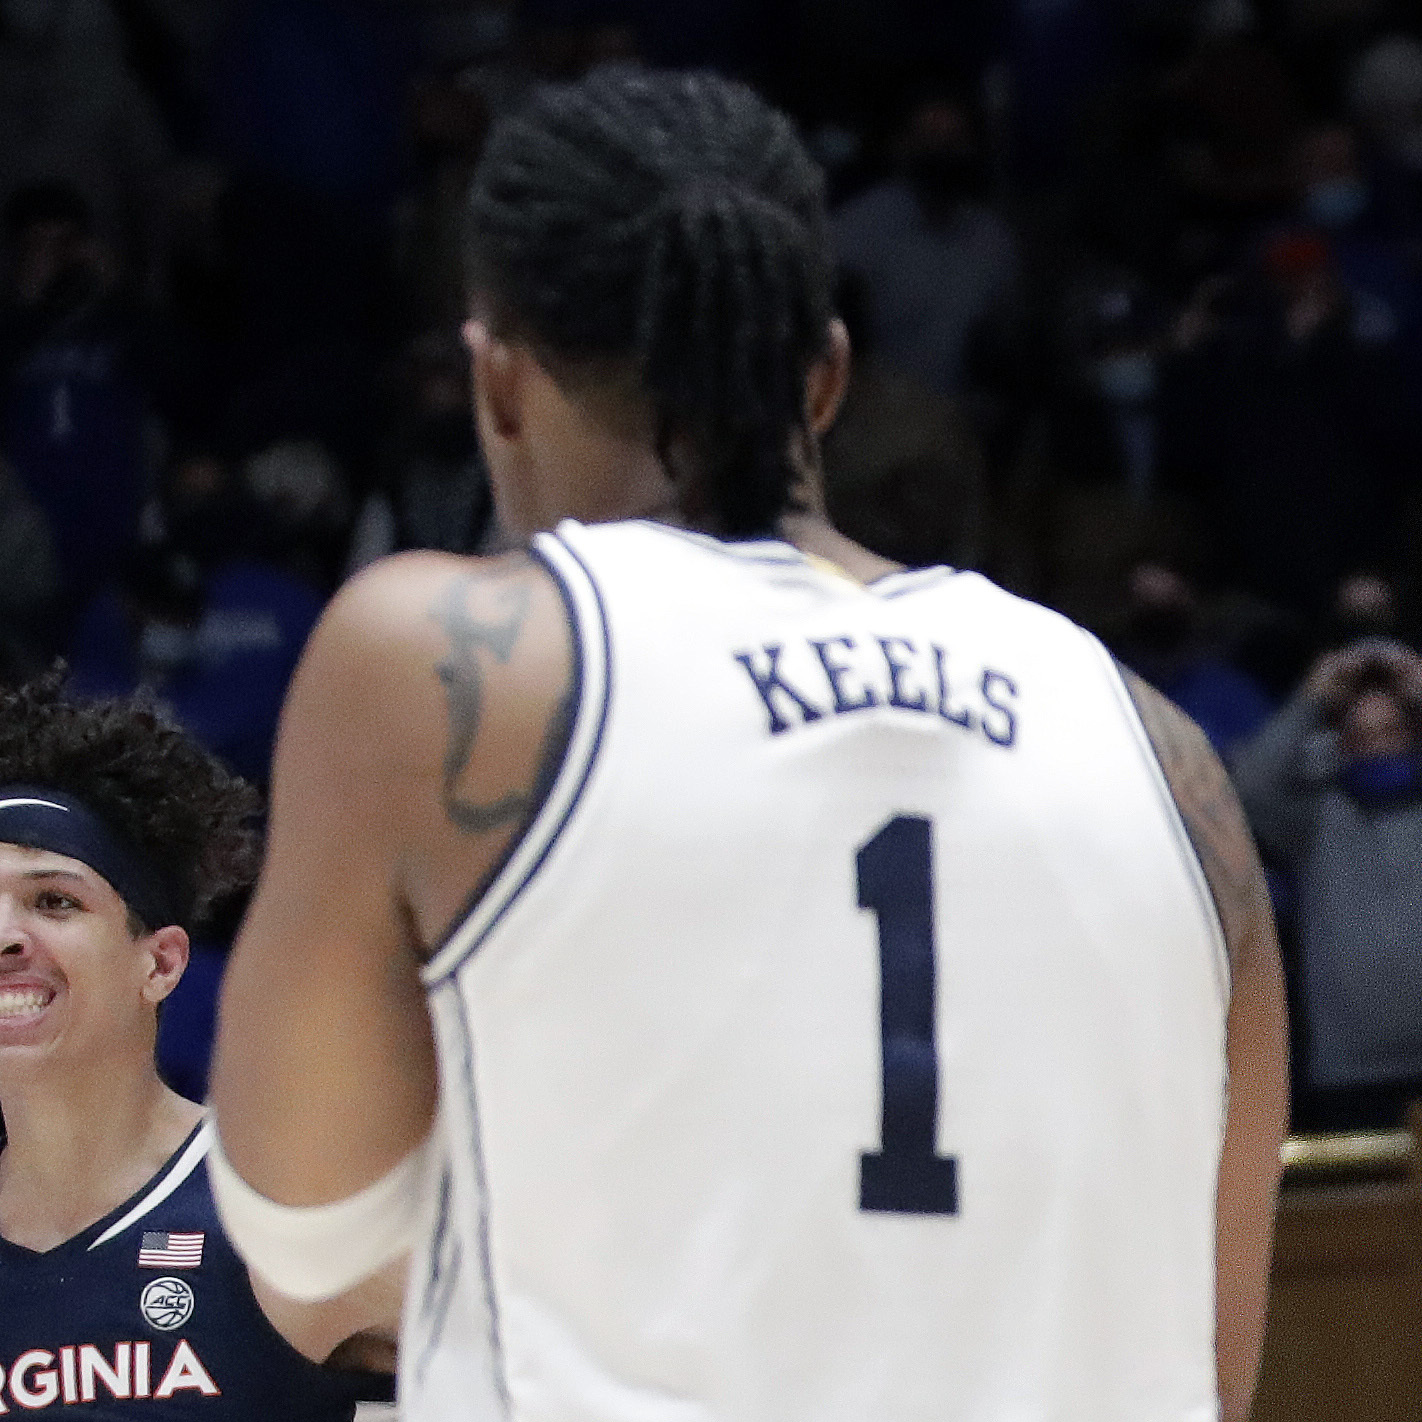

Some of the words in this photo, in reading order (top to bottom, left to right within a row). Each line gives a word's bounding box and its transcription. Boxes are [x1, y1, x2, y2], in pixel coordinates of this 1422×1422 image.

[731, 635, 1020, 748] KEELS
[857, 815, 960, 1215] 1
[0, 1338, 223, 1415] GINIA
